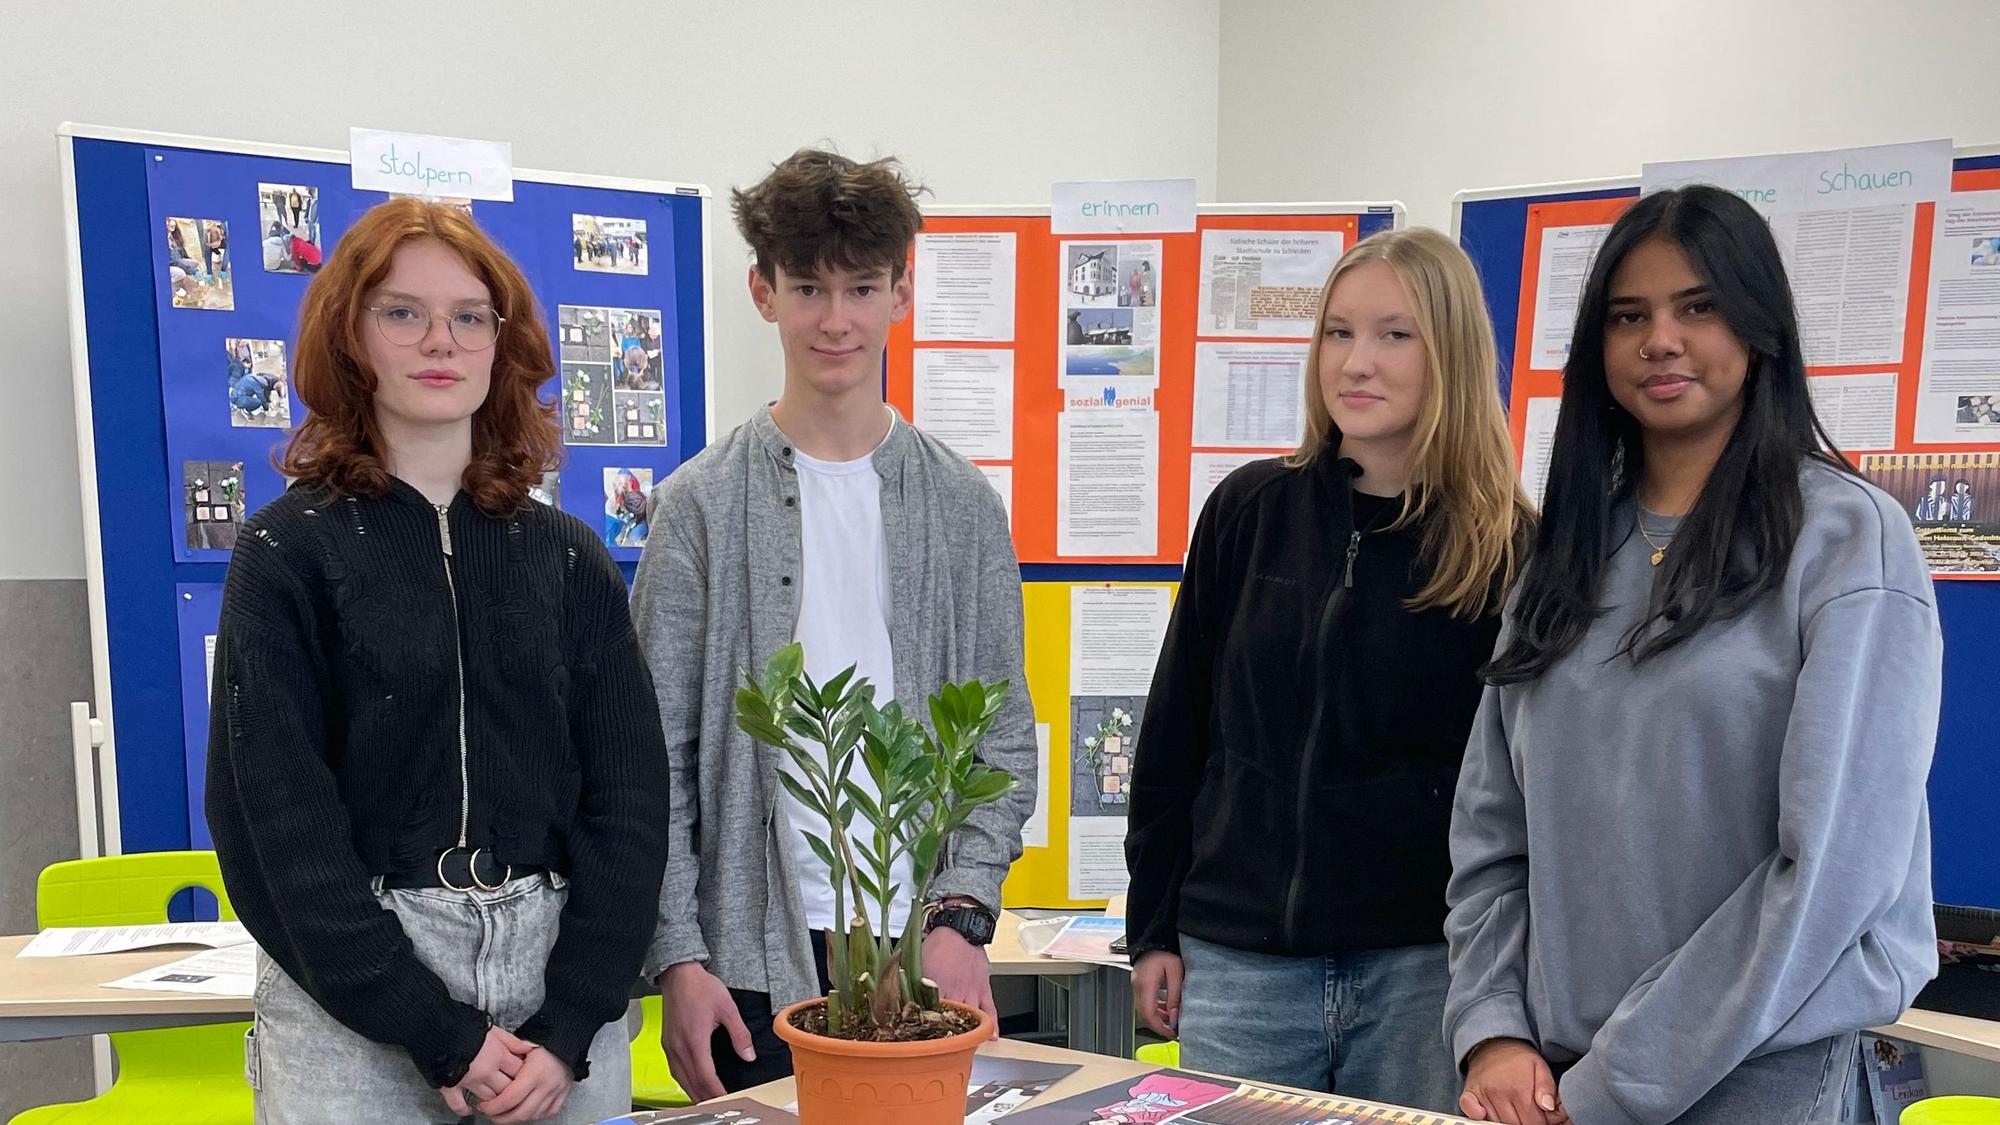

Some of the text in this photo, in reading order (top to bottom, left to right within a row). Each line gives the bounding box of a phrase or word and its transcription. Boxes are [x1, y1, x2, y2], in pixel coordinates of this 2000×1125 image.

[379, 142, 472, 187] stolpern
[1735, 188, 1777, 203] orne
[1081, 200, 1159, 217] erinnern
[1070, 396, 1151, 409] sozial genial
